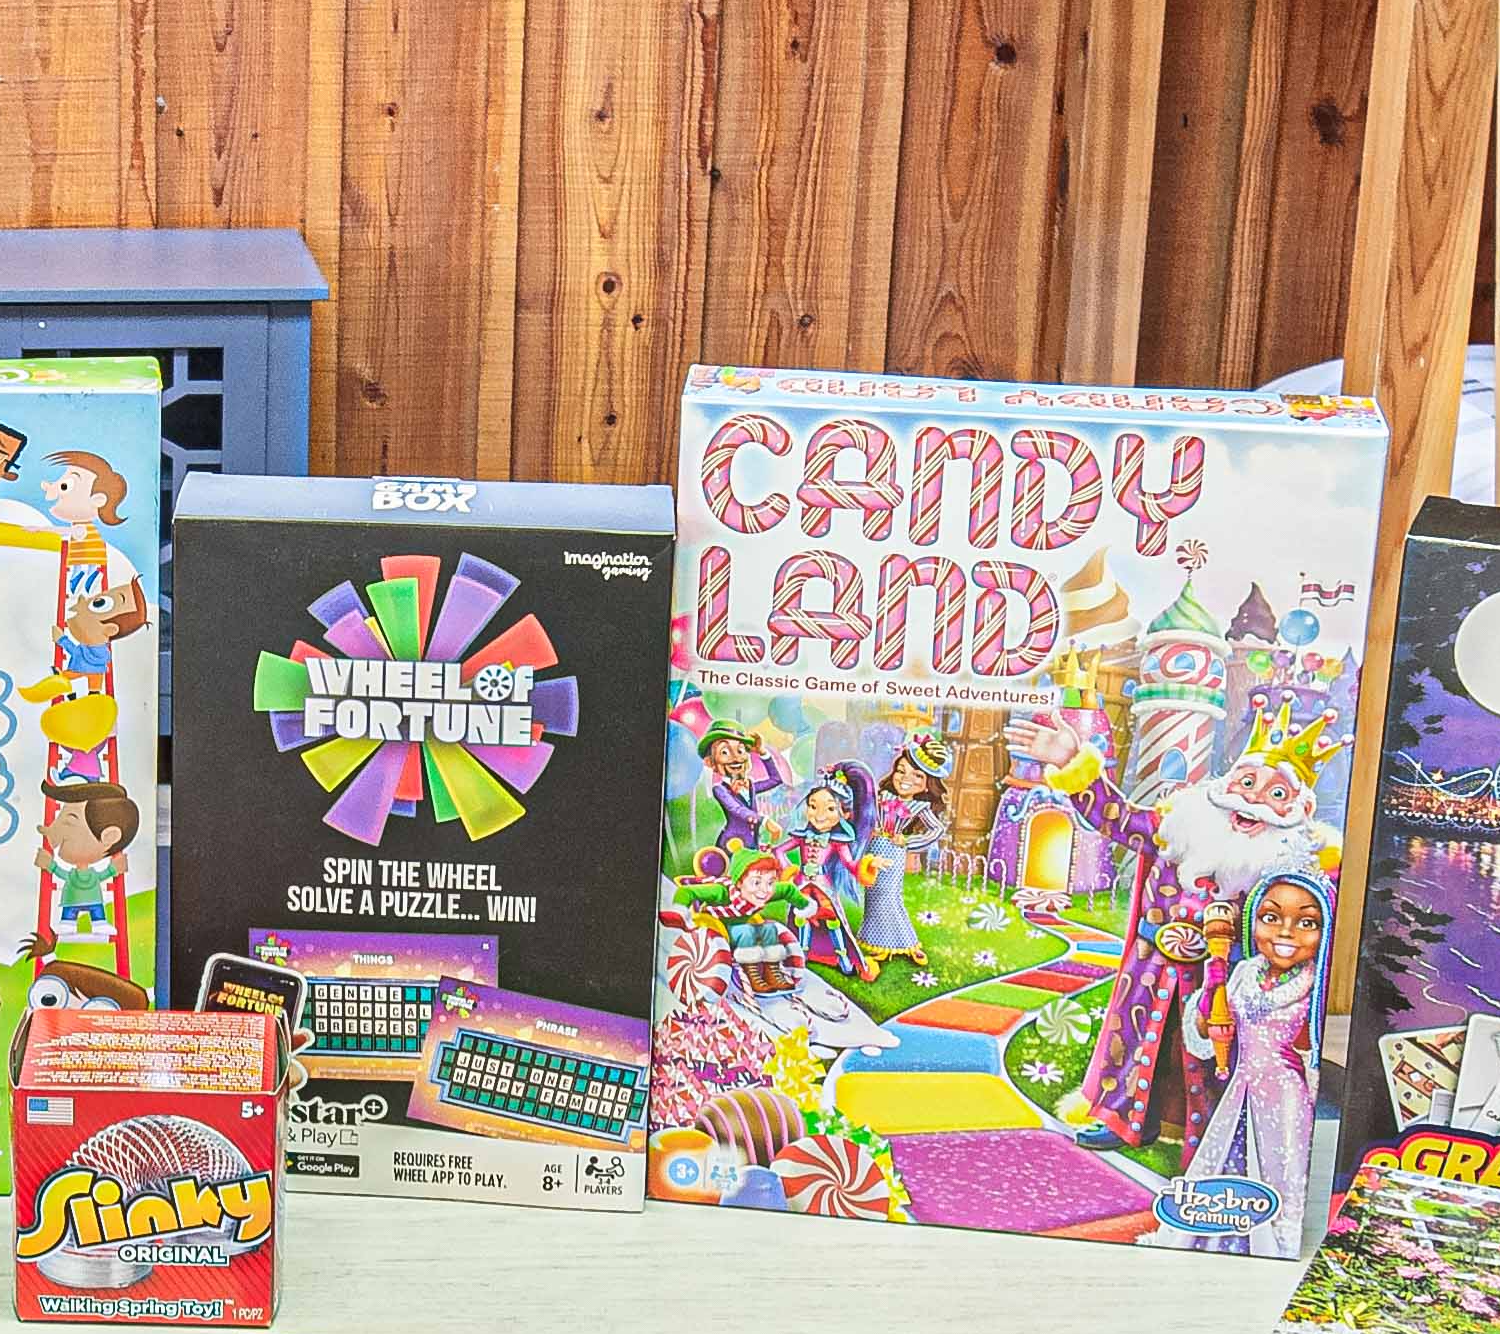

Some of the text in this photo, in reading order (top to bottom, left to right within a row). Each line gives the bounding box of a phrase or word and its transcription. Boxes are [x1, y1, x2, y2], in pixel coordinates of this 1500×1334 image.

[701, 413, 1206, 556] CANDY
[371, 492, 474, 514] BOX
[696, 545, 1061, 678] LAND
[304, 658, 475, 701] WHEEL
[698, 671, 1057, 707] The Classic Game of Sweet Adventures!
[304, 698, 534, 747] FORTUNE
[322, 857, 503, 893] SPIN THE WHEEL
[287, 886, 537, 924] SOLVE A PUZZLE... WIN!
[352, 954, 394, 965] THINGS
[535, 1020, 580, 1037] PHRASE
[241, 1102, 264, 1118] 5+
[393, 1151, 473, 1169] REQUIRES FREE
[543, 1163, 563, 1174] AGE
[393, 1168, 508, 1189] WHEEL APP TO PLAY.
[585, 1183, 623, 1196] PLAYERS
[1170, 1180, 1272, 1215] Hasbro
[17, 1170, 271, 1258] Slinky
[1182, 1206, 1256, 1232] Gaming
[119, 1246, 228, 1265] ORIGINAL
[40, 1296, 222, 1318] Walking Spring Toy!
